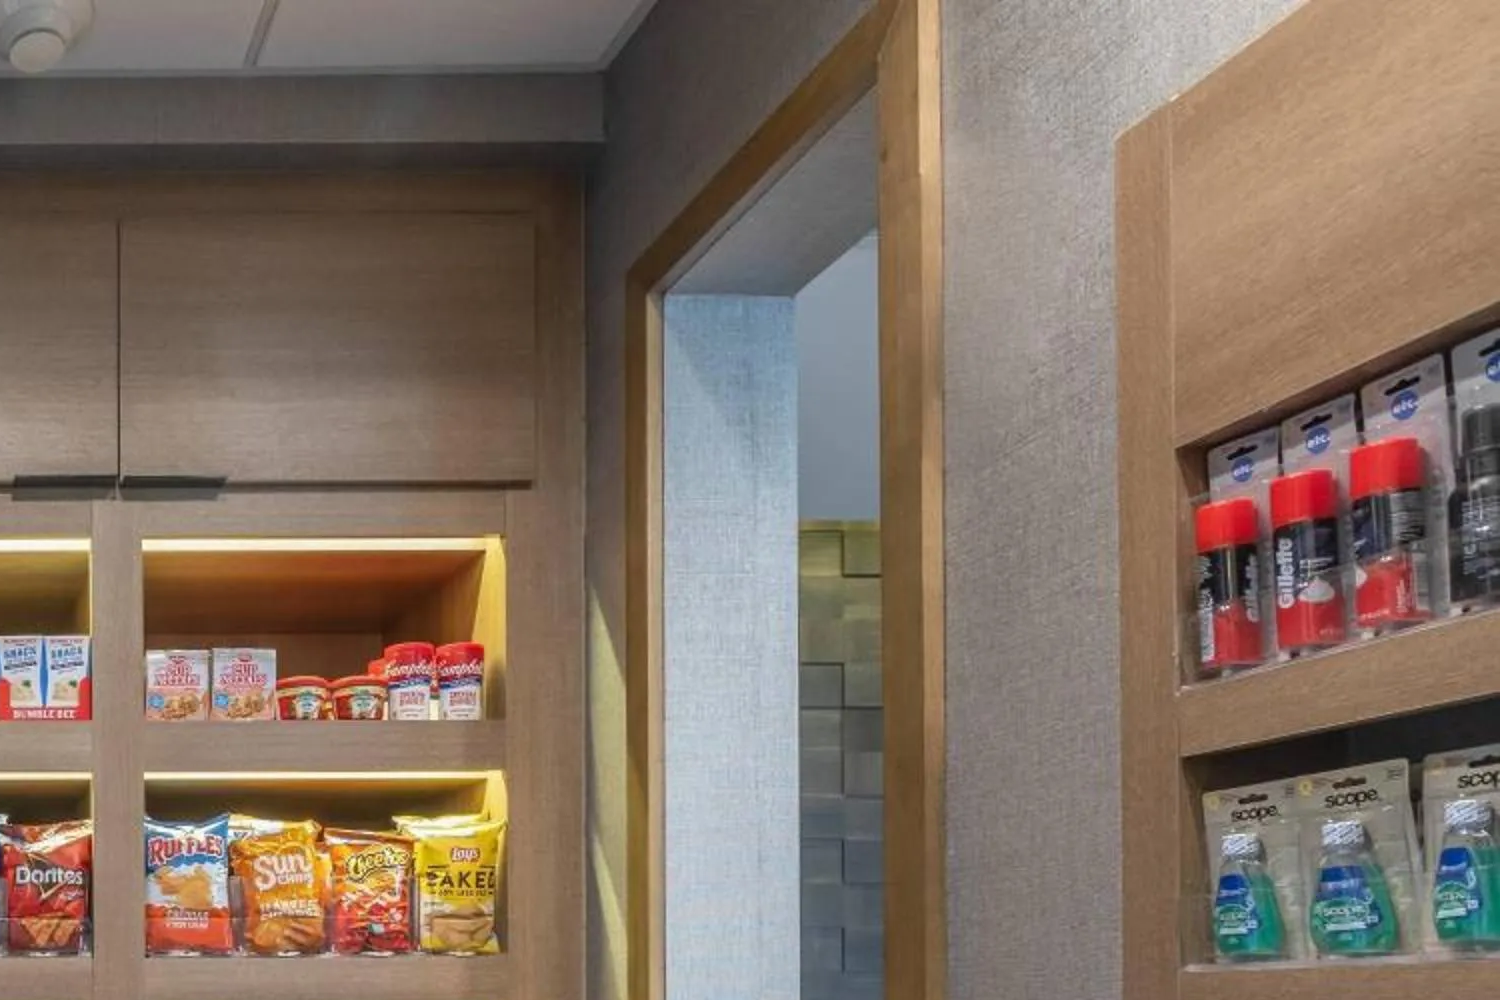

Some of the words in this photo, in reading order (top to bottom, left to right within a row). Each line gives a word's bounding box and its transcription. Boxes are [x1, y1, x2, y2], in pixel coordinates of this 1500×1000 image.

[1276, 538, 1295, 609] Gillette
[1457, 771, 1500, 789] scop
[1325, 788, 1379, 808] scope
[1231, 804, 1278, 825] scope
[148, 834, 225, 866] RUFFLES
[15, 867, 83, 885] Doritos
